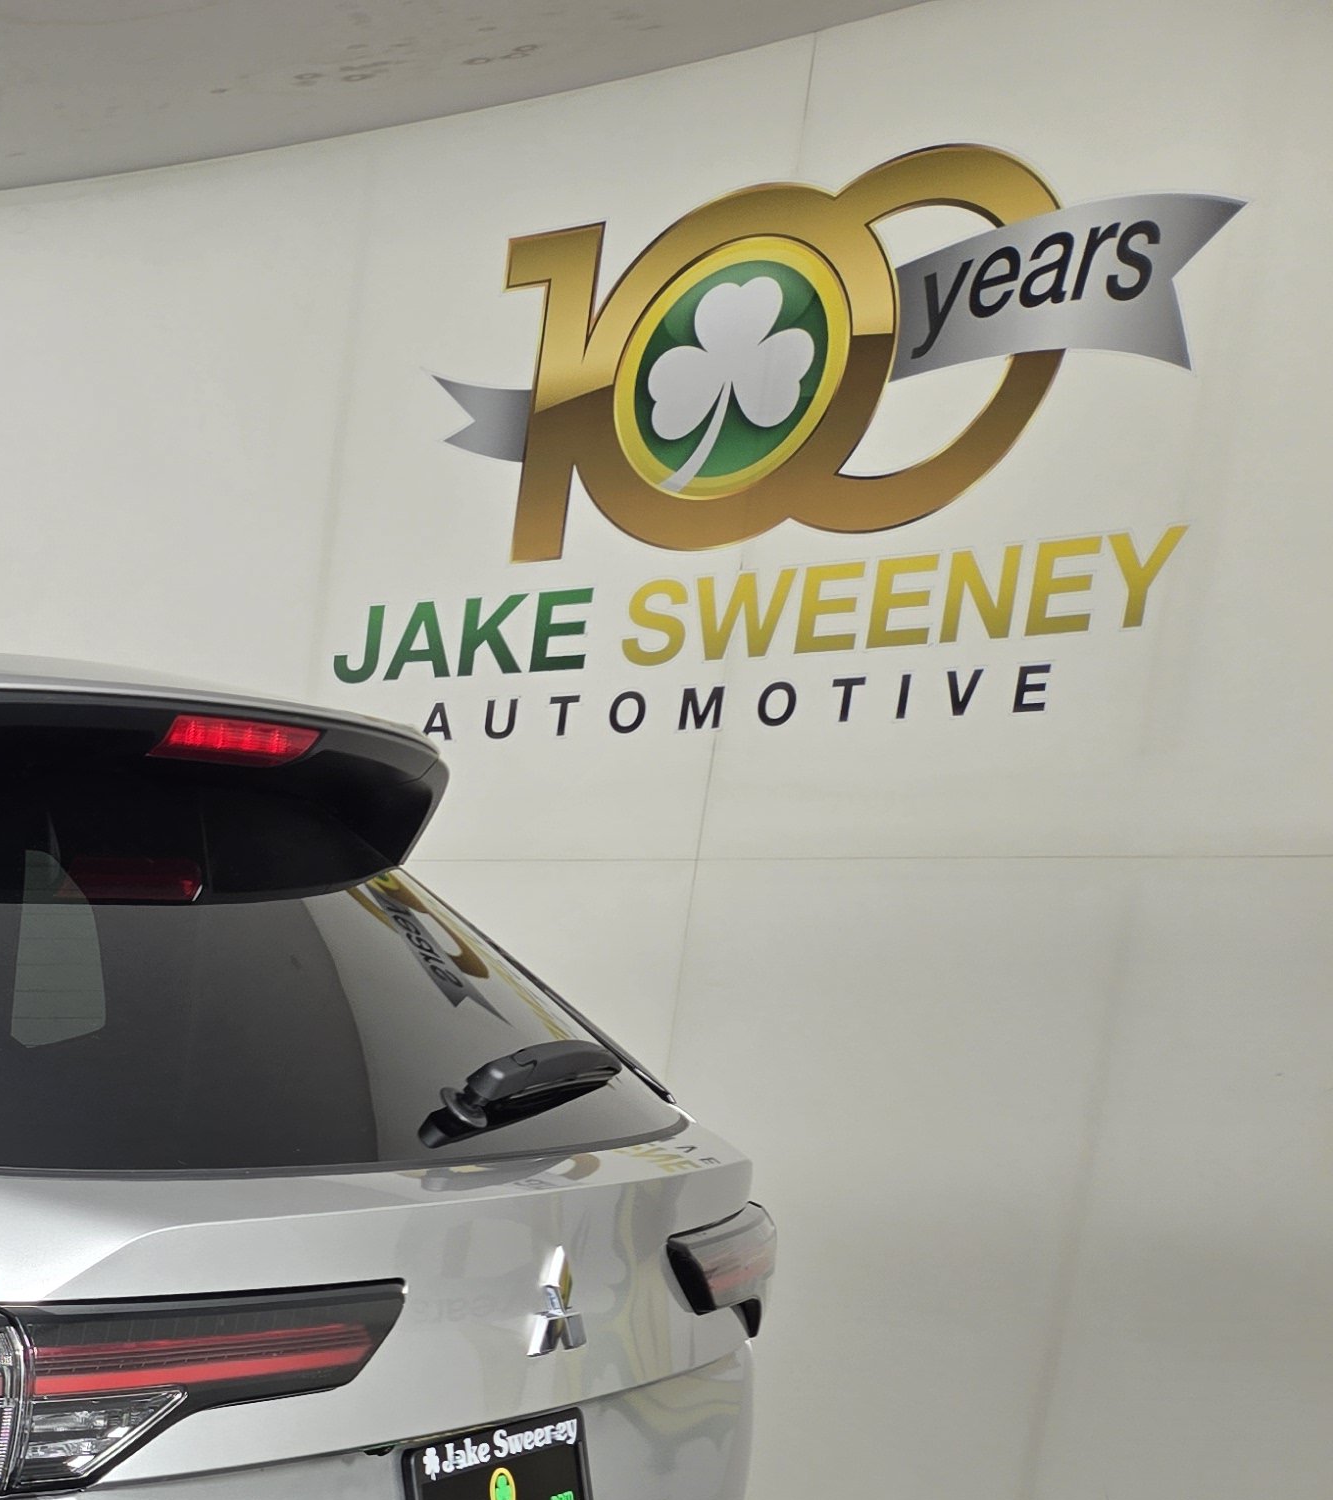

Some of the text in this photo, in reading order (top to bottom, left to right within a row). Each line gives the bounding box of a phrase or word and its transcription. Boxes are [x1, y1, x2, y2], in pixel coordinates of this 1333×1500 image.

[912, 219, 1160, 359] years
[333, 525, 1189, 684] JAKE SWEENEY
[423, 664, 1053, 741] AUTOMOTIVE
[442, 1438, 490, 1473] Jake
